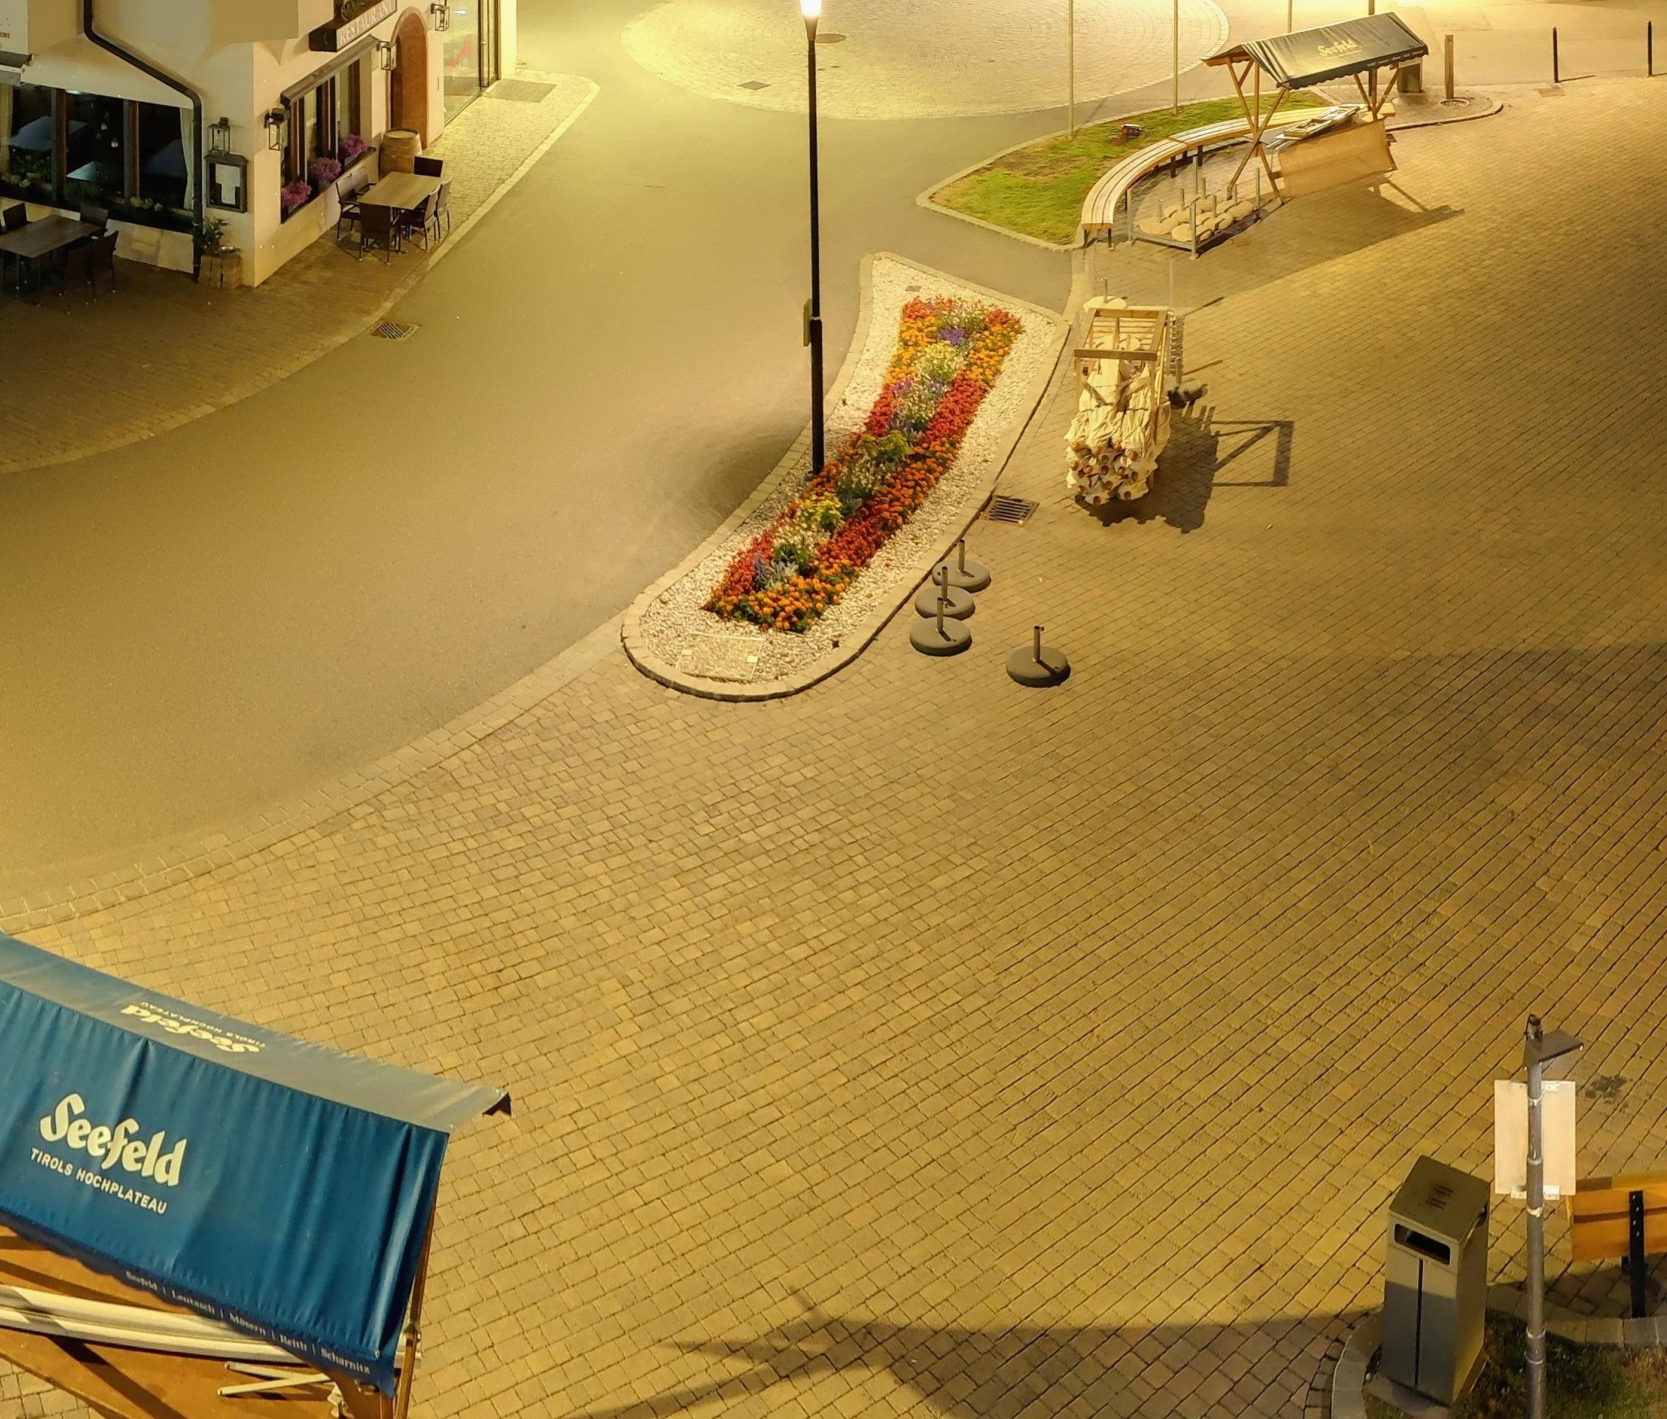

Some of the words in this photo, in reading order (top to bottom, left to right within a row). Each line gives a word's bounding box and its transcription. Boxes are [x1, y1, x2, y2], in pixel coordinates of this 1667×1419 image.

[339, 0, 396, 46] RESTAURANT
[1317, 38, 1358, 57] Seefeld
[120, 1004, 261, 1054] Seefeld
[140, 1001, 223, 1034] HOCHPLATEAU
[226, 1031, 267, 1049] TIROLS
[39, 1093, 188, 1188] Seefeld
[30, 1147, 74, 1177] TIROLS
[76, 1167, 168, 1215] HOCHPLATEAU
[125, 1270, 158, 1292] Seefeld
[171, 1289, 216, 1316] Leutasch
[229, 1312, 267, 1337] Mösern
[279, 1334, 308, 1352] Reith
[320, 1347, 371, 1375] Scharnitz
